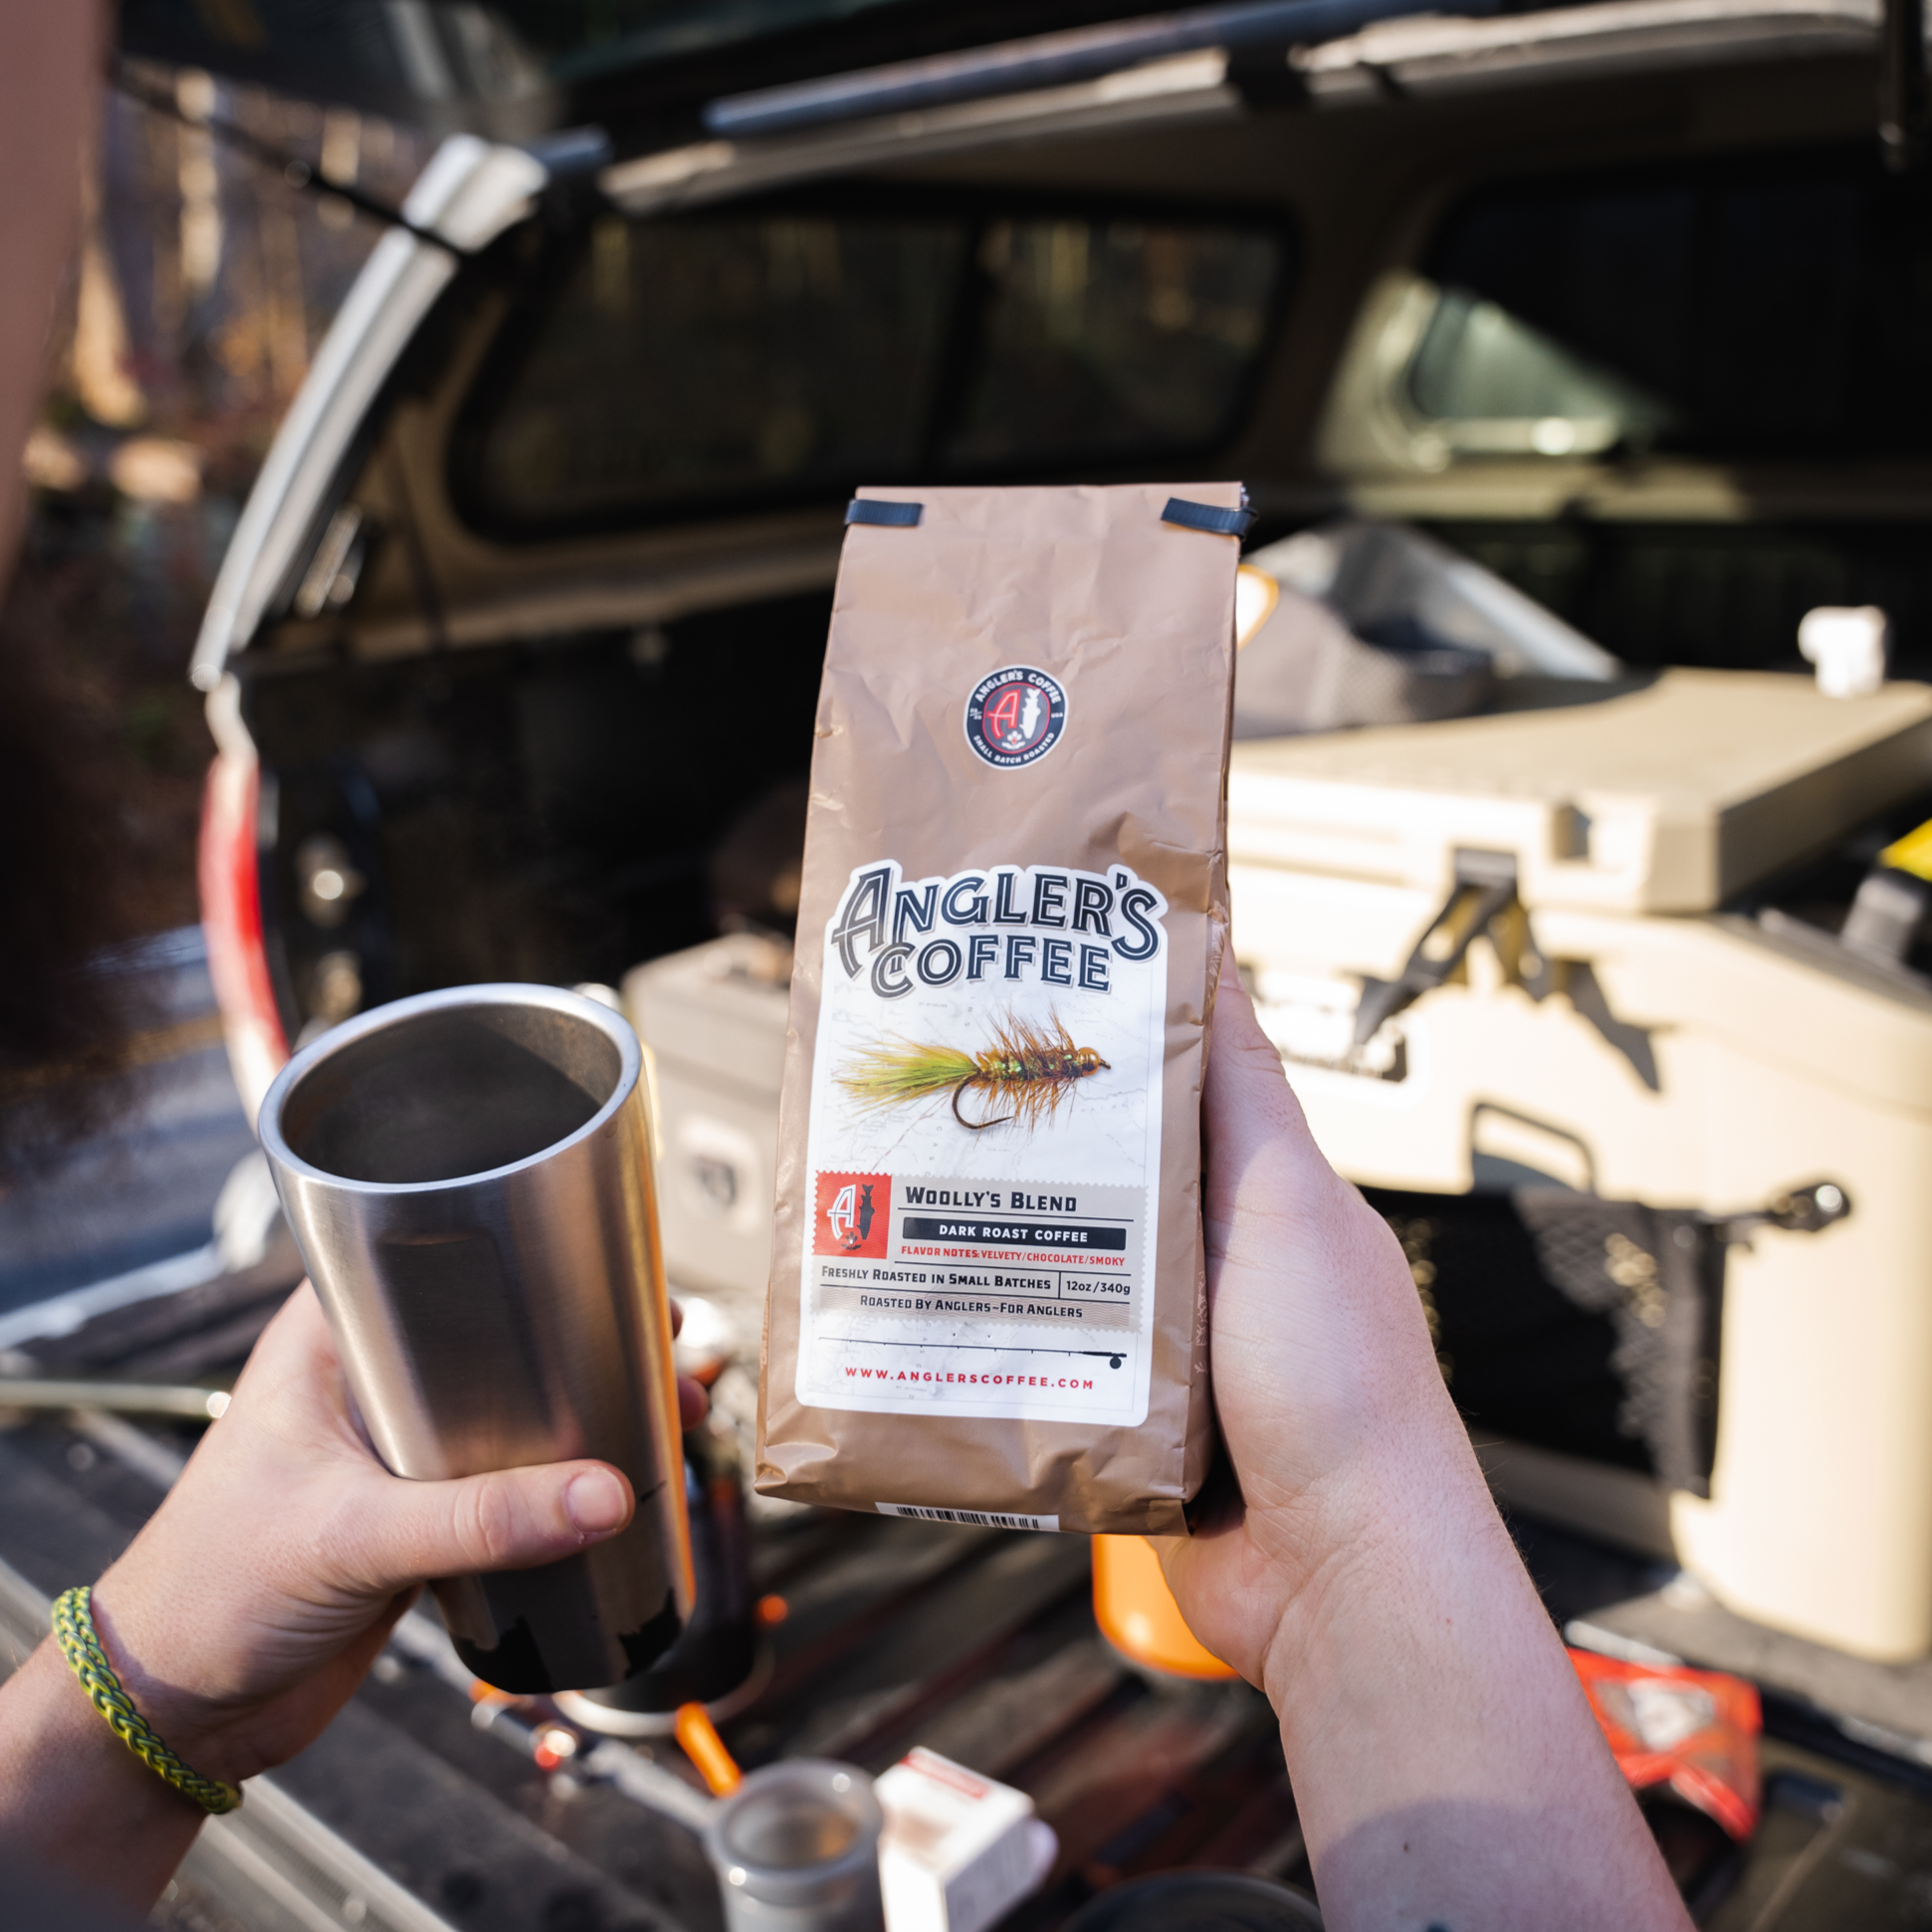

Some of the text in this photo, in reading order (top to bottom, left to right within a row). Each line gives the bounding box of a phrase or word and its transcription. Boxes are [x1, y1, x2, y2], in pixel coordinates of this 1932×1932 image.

[974, 669, 1062, 704] ANGLER'S COFFEE
[973, 732, 1055, 764] SMALL BATCH ROASTED
[830, 867, 1161, 979] ANGLER'S
[871, 934, 1111, 998] COFFEE
[905, 1186, 1077, 1212] WOOLLY'S BLEND
[939, 1224, 1088, 1243] DARK ROAST COFFEE
[901, 1245, 941, 1256] FLAVOR
[821, 1265, 1051, 1290] FRESHLY ROASTED IN SMALL BATCHES
[860, 1295, 912, 1307] ROASTED
[1026, 1303, 1083, 1318] ANGLERS
[845, 1366, 1094, 1391] WWW.ANGLERSCOFFEE.COM
